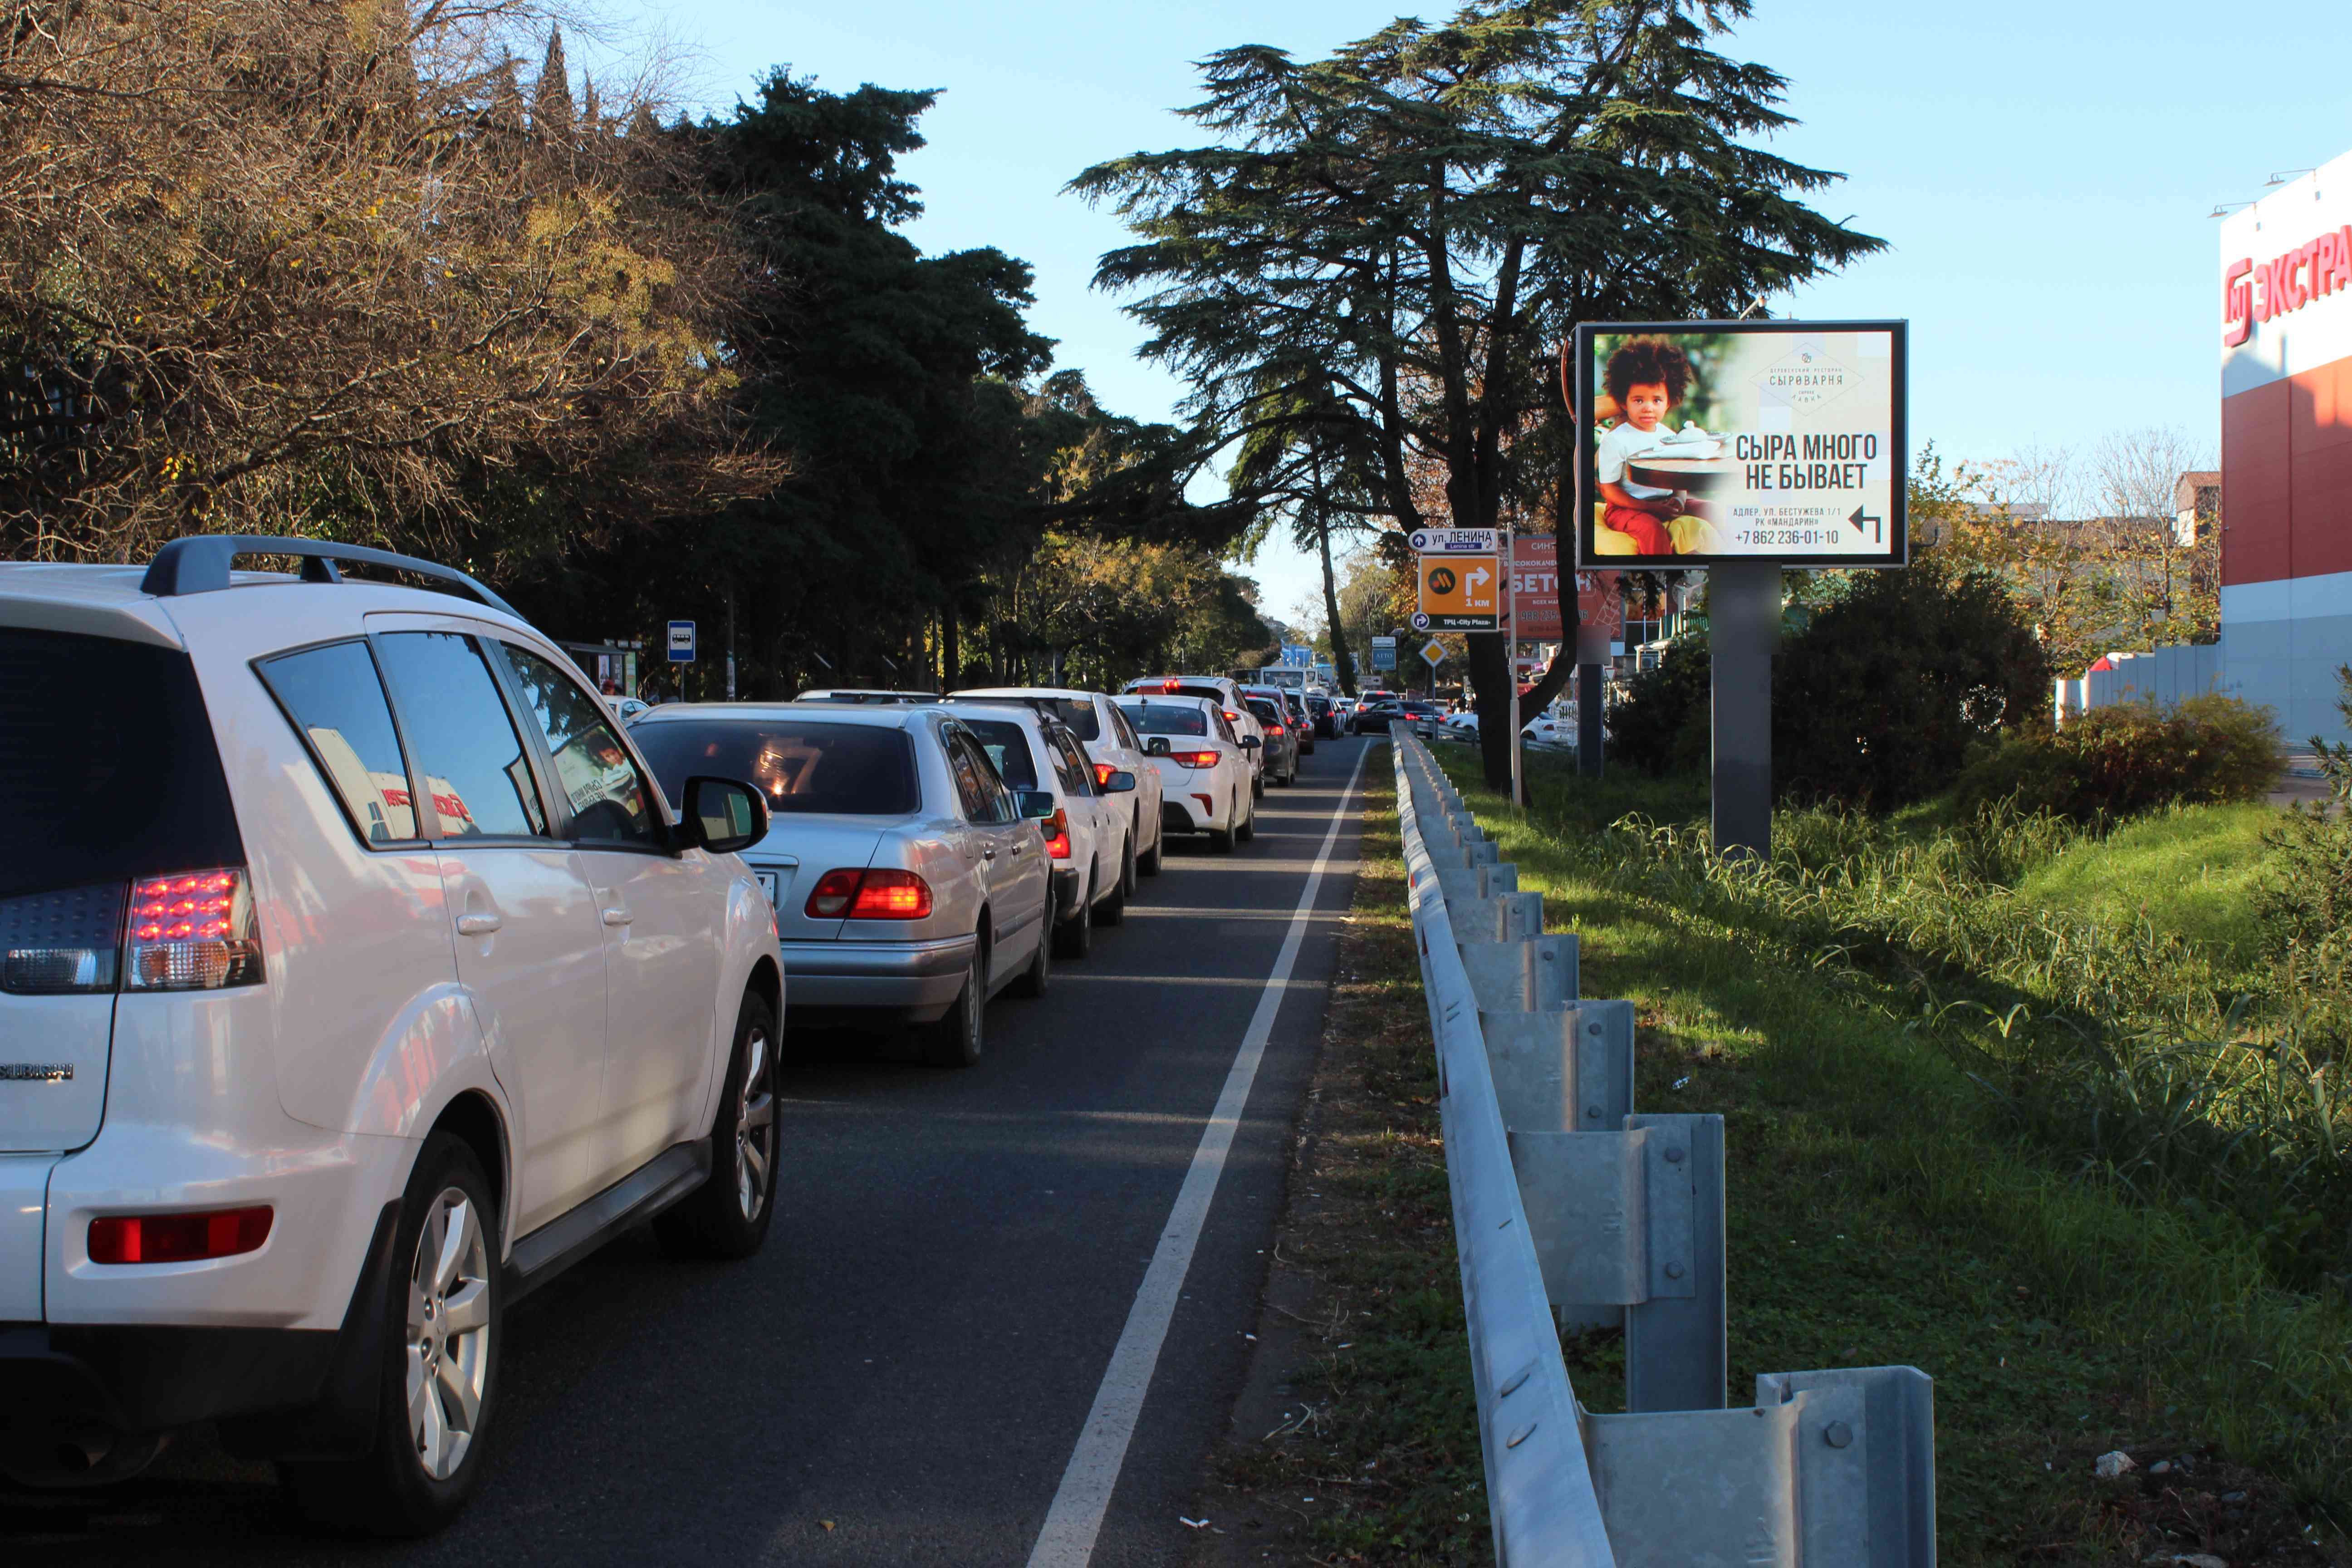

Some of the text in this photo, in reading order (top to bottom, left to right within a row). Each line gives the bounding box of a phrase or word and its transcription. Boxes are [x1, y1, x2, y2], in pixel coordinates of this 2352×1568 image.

[2254, 225, 2352, 323] ЭКСТРА
[1769, 375, 1842, 385] СЫРОВАРНЯ
[1736, 434, 1877, 461] СЫРА МНОГО
[1746, 464, 1867, 489] НЕ БЫВАЕТ
[1779, 508, 1824, 516] БЕСТУЖЕВА
[1828, 508, 1840, 516] 1/1
[1755, 518, 1818, 527] РК «МАНДАРИН»
[1432, 531, 1492, 545] ул. ЛЕНИНА
[1735, 530, 1838, 544] +7 862 236-01-10
[1514, 573, 1591, 593] БЕТН
[1466, 598, 1472, 607] 1
